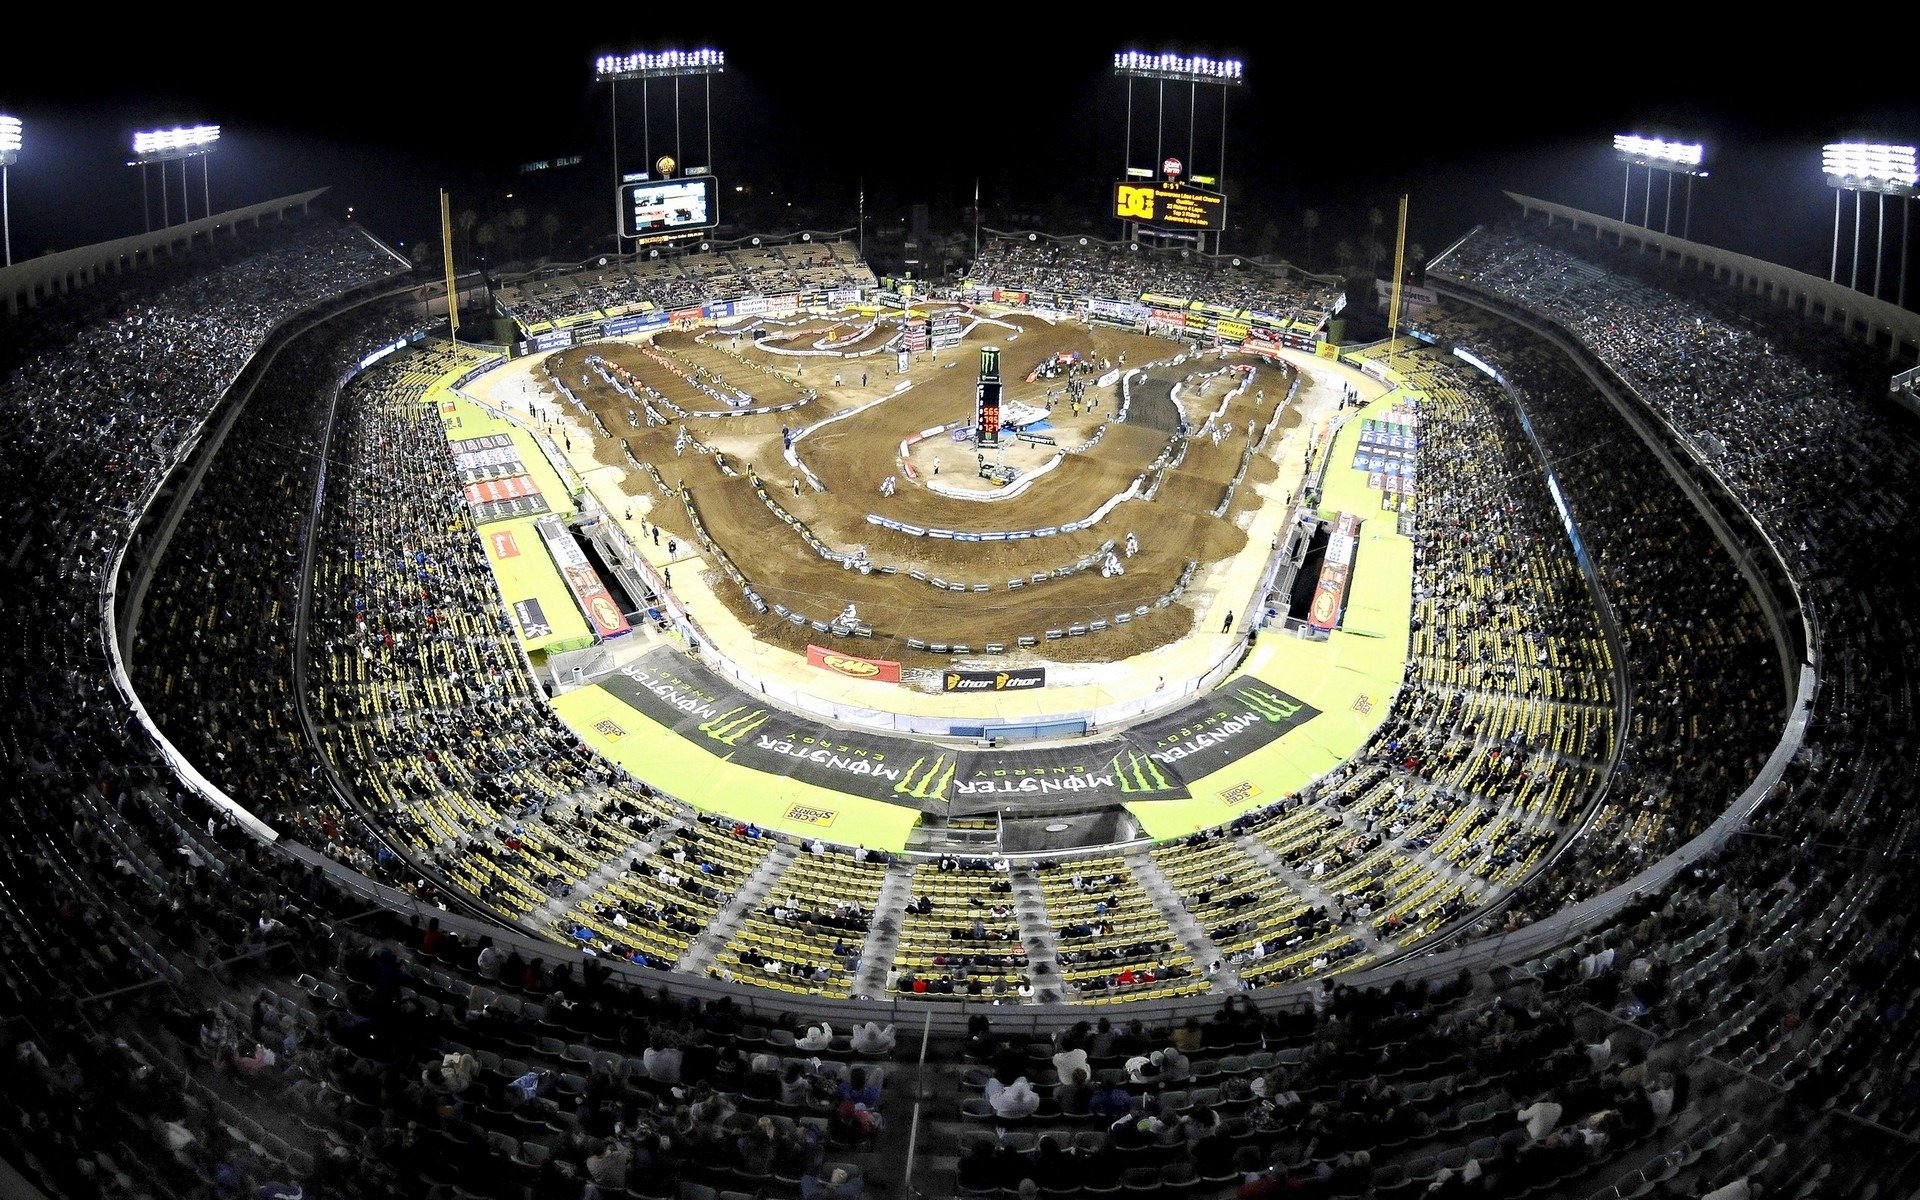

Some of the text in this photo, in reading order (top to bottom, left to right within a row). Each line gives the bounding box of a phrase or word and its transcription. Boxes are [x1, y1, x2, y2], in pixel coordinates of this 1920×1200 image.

[521, 160, 550, 173] THINK
[649, 668, 716, 703] ENERGY
[958, 676, 1041, 689] thor thor
[1156, 711, 1227, 748] ENERGY
[786, 733, 885, 761] ENERGY
[974, 764, 1084, 777] ENERGY
[787, 812, 809, 821] CBS
[792, 806, 834, 819] SPORTS
